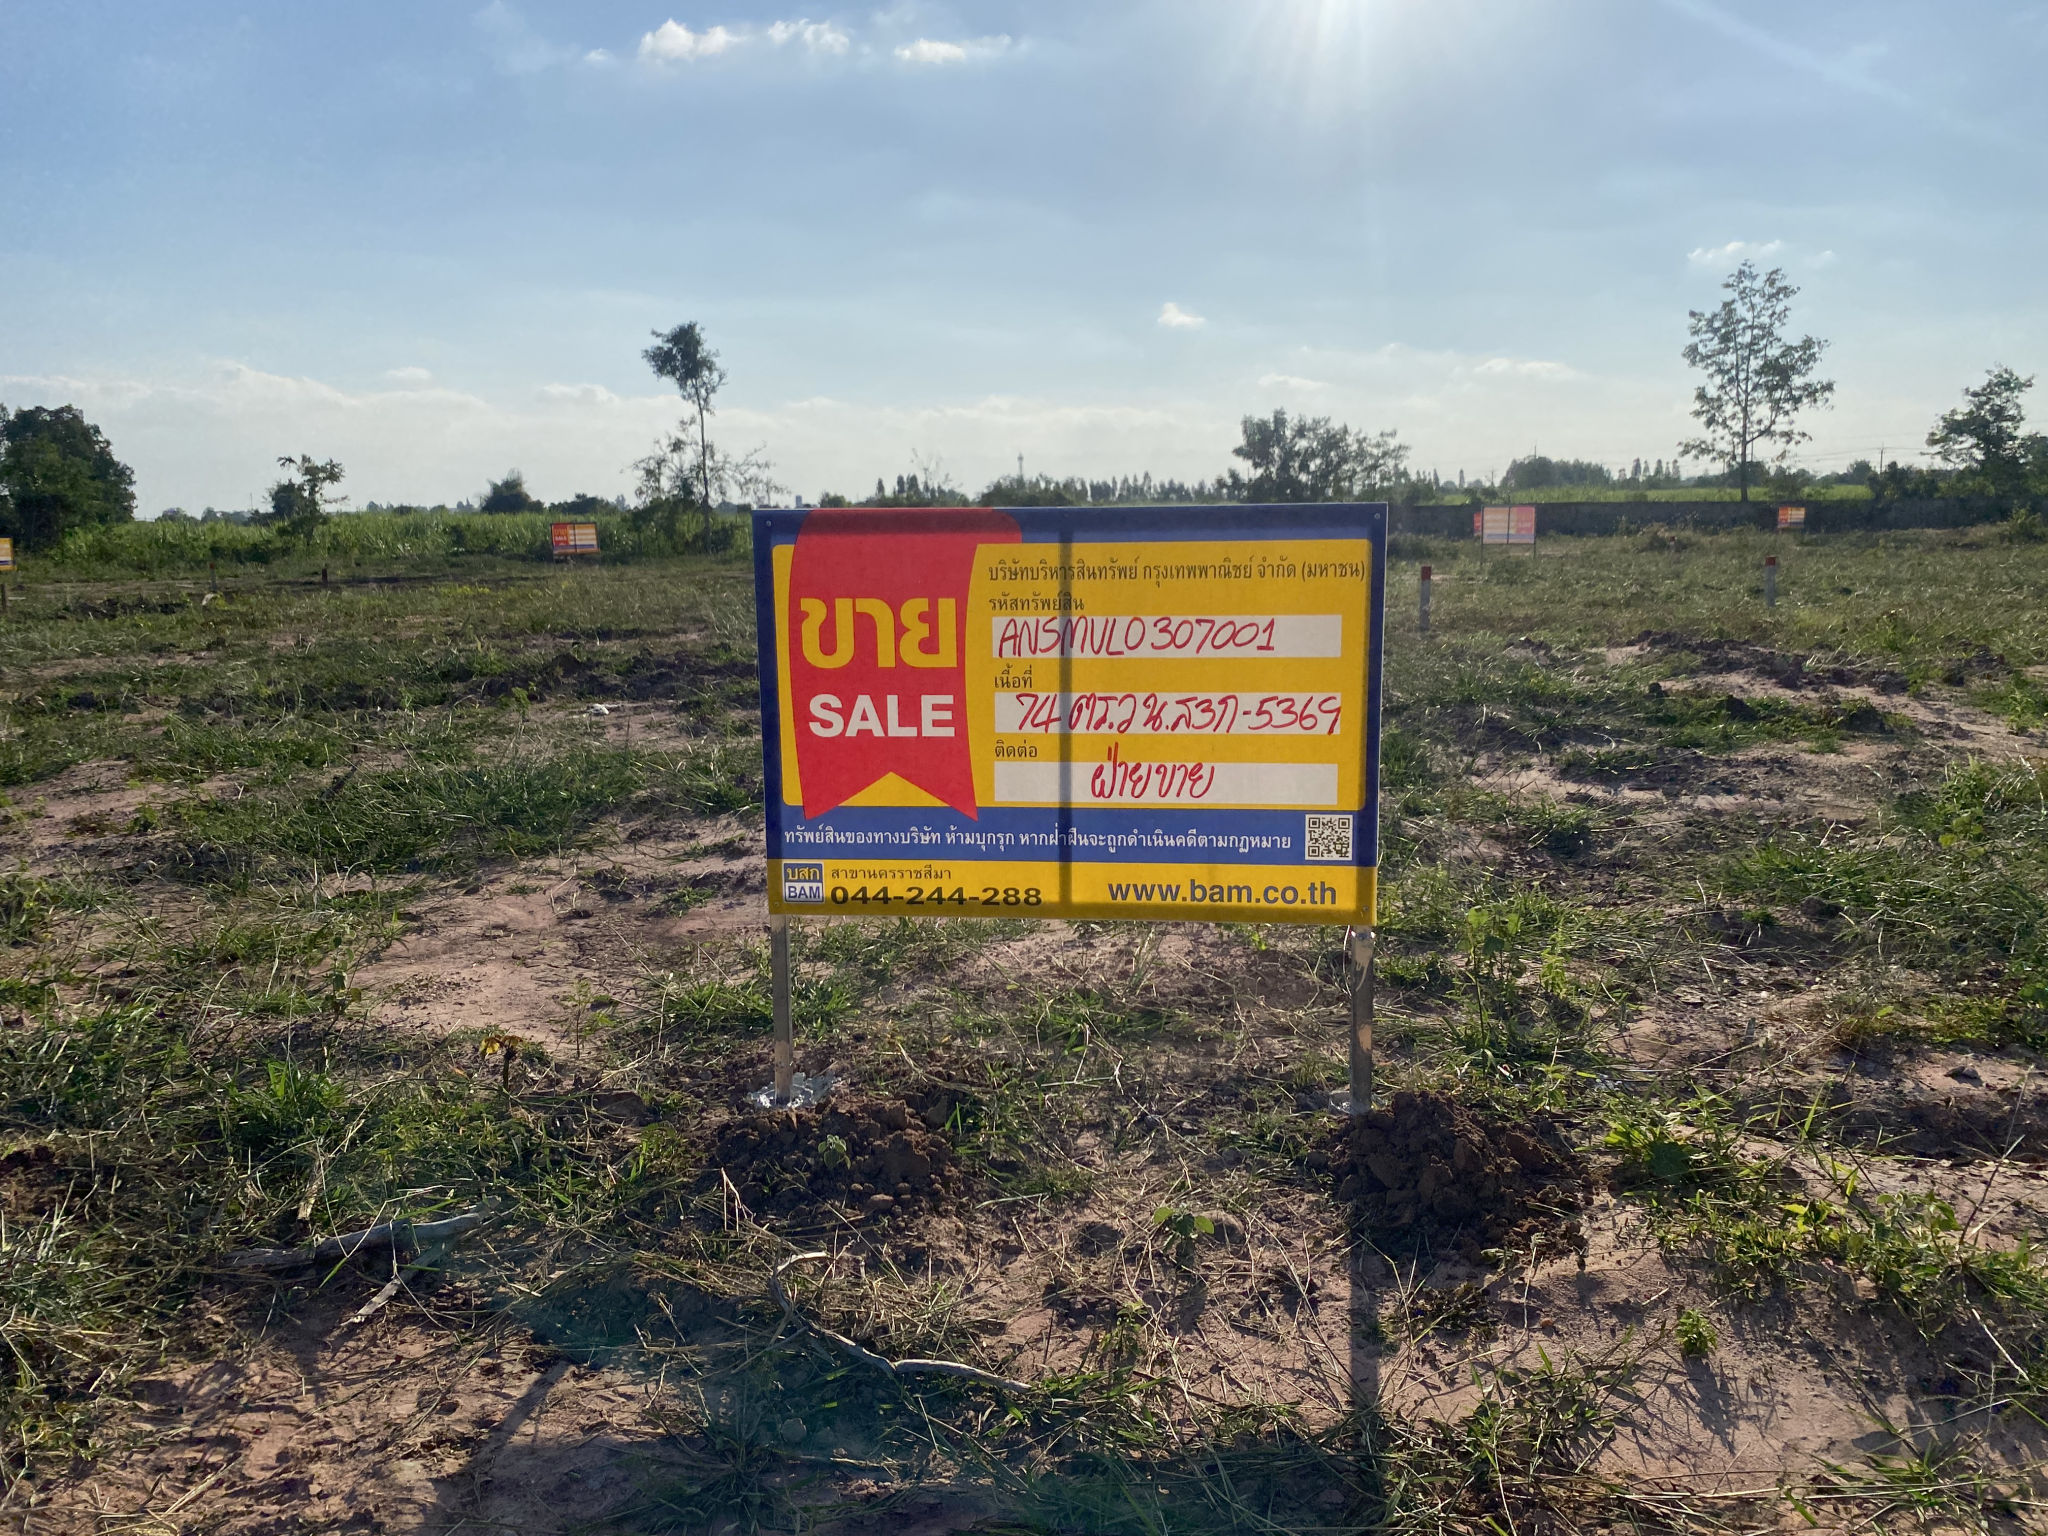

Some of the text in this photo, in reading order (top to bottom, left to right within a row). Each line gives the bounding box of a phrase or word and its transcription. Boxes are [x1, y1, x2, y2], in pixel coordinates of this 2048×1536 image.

[1143, 555, 1253, 588] กรุงเทพพาณิชย์
[1257, 555, 1297, 578] จำกัด
[1301, 560, 1366, 582] (มหาชน)
[989, 591, 1085, 611] รหัสทรัพย์สิน
[801, 597, 957, 669] ขาย
[994, 664, 1033, 689] เนื้อที่
[809, 693, 956, 738] SALE
[995, 739, 1038, 758] ติดต่อ
[784, 823, 941, 845] ทรัพย์สินของทางบริษัท
[945, 824, 1015, 852] ห้ามบุกรุก
[831, 864, 952, 880] สาขานครราชสีมา
[788, 885, 821, 900] BAM
[830, 886, 1042, 907] 044-244-288
[1107, 879, 1337, 905] www.bam.co.th
